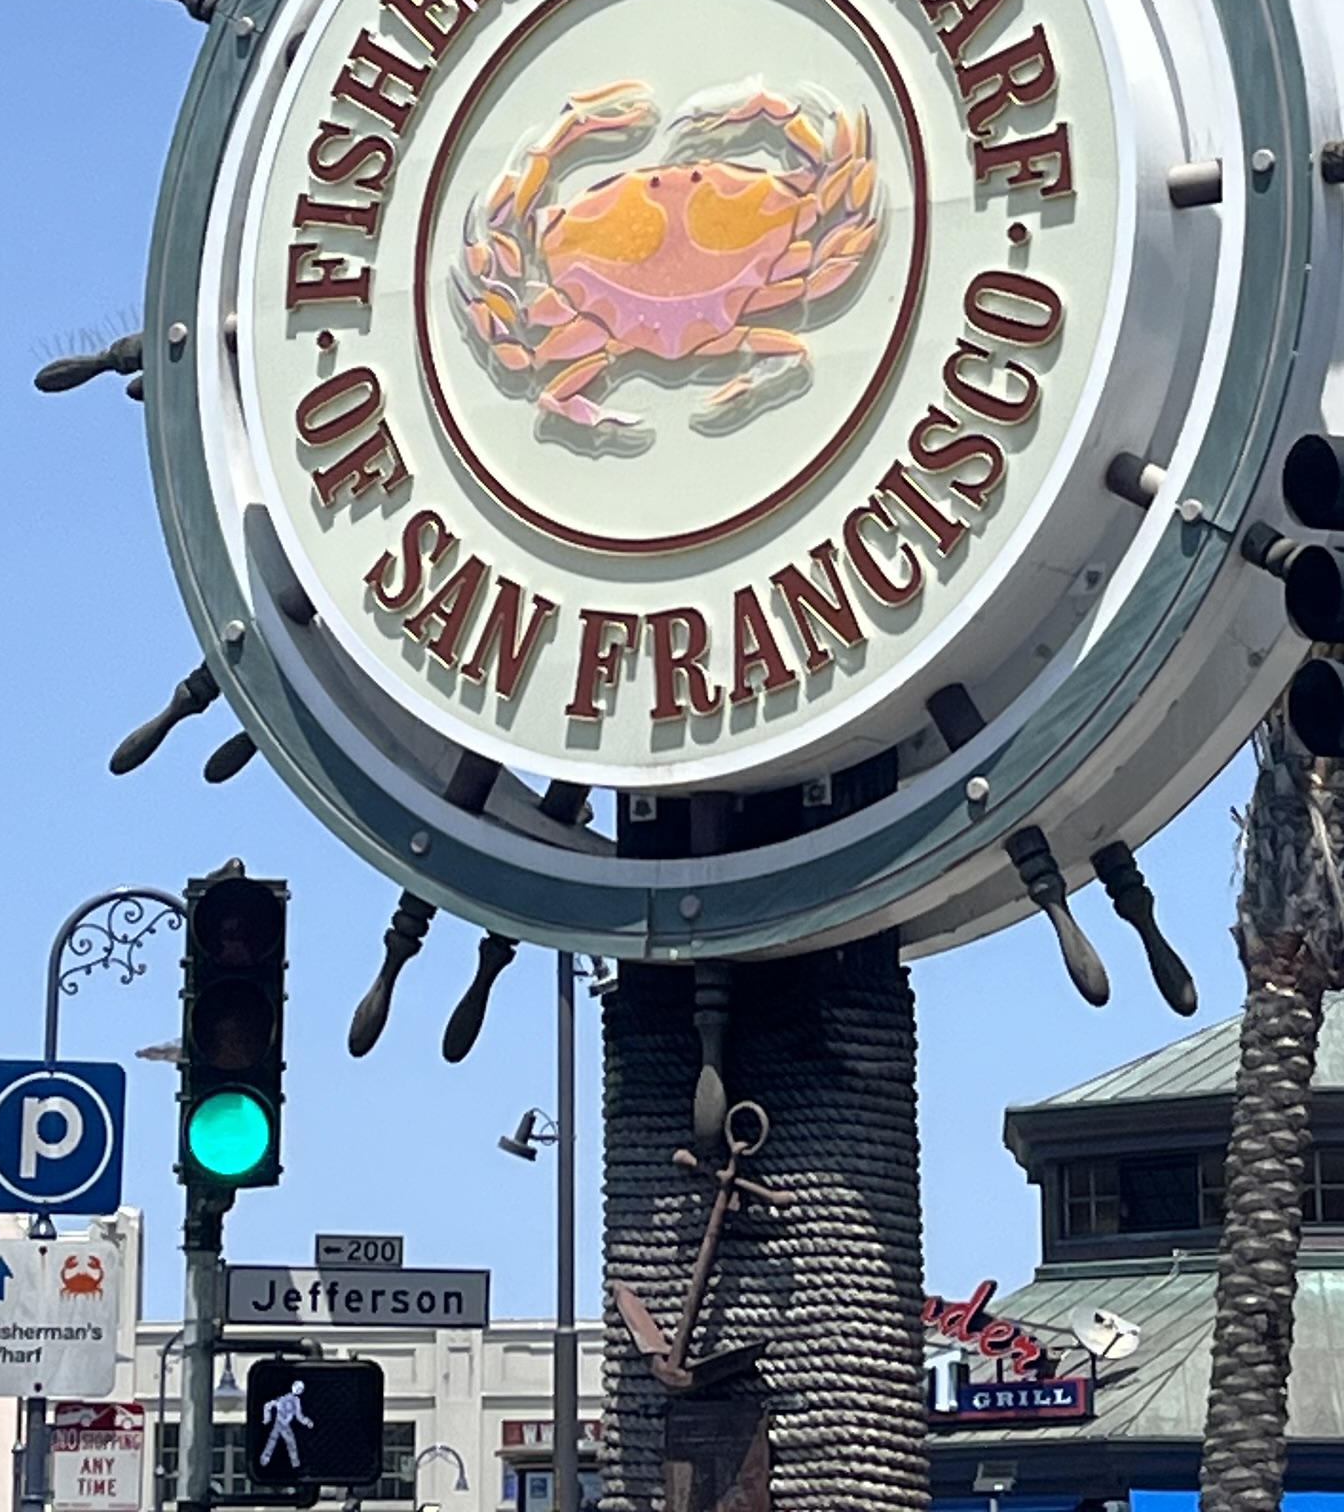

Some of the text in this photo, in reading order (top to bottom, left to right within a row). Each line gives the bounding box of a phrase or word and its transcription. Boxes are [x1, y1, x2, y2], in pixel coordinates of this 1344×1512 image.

[296, 269, 1066, 723] OF SAN FRANCISCO
[347, 1240, 397, 1262] 200
[251, 1279, 464, 1315] Jefferson
[971, 1387, 1073, 1411] GRILL
[80, 1456, 115, 1475] ANY
[77, 1477, 117, 1497] TIME
